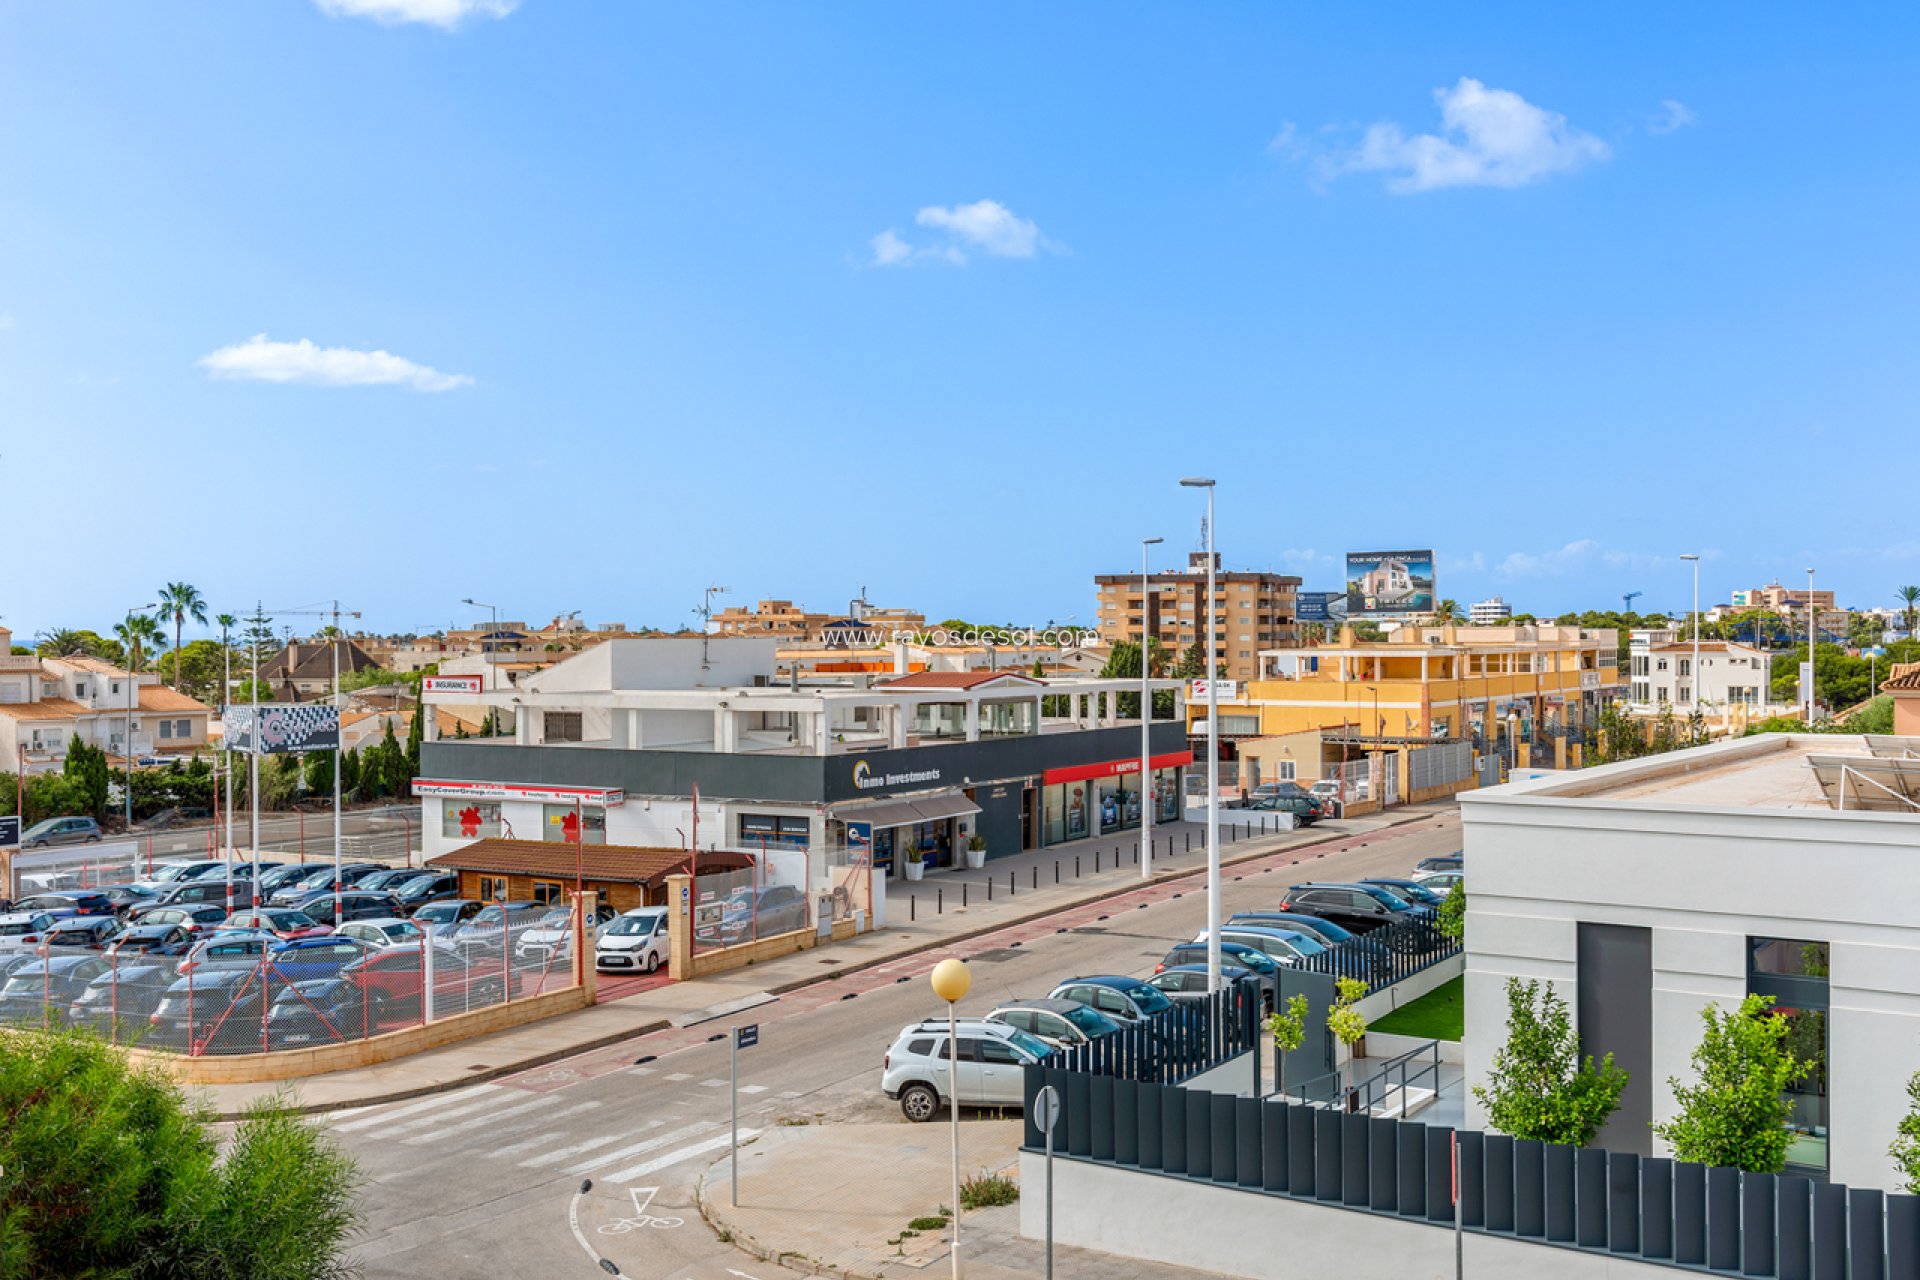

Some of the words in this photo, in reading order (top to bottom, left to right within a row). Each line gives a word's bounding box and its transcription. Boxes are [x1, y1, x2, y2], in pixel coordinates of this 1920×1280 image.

[435, 681, 467, 689] INSURANCE
[1115, 761, 1140, 772] MAPFRE
[886, 768, 940, 786] Investments
[417, 785, 505, 796] EasyCoverGroup.com
